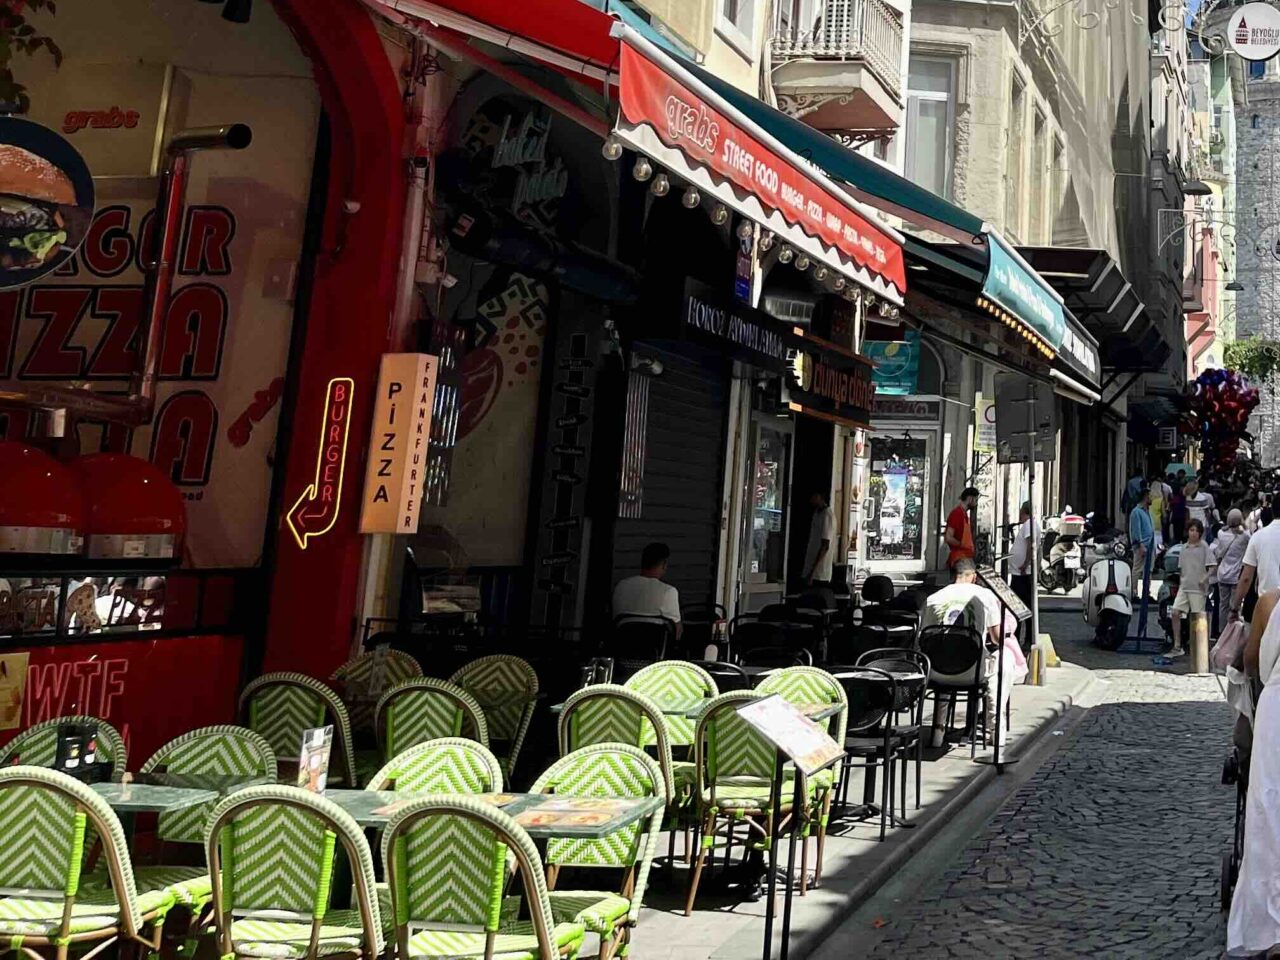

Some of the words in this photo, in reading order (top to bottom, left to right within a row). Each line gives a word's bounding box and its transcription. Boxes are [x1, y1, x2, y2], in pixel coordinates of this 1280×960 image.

[1251, 26, 1280, 38] BEYOĞLU
[63, 106, 140, 134] grabs
[665, 95, 719, 153] grabs
[721, 136, 755, 184] STREET
[755, 161, 779, 195] FOOD
[322, 384, 346, 503] BURGER
[404, 361, 431, 528] FRANKFURTER
[27, 658, 129, 727] WTF
